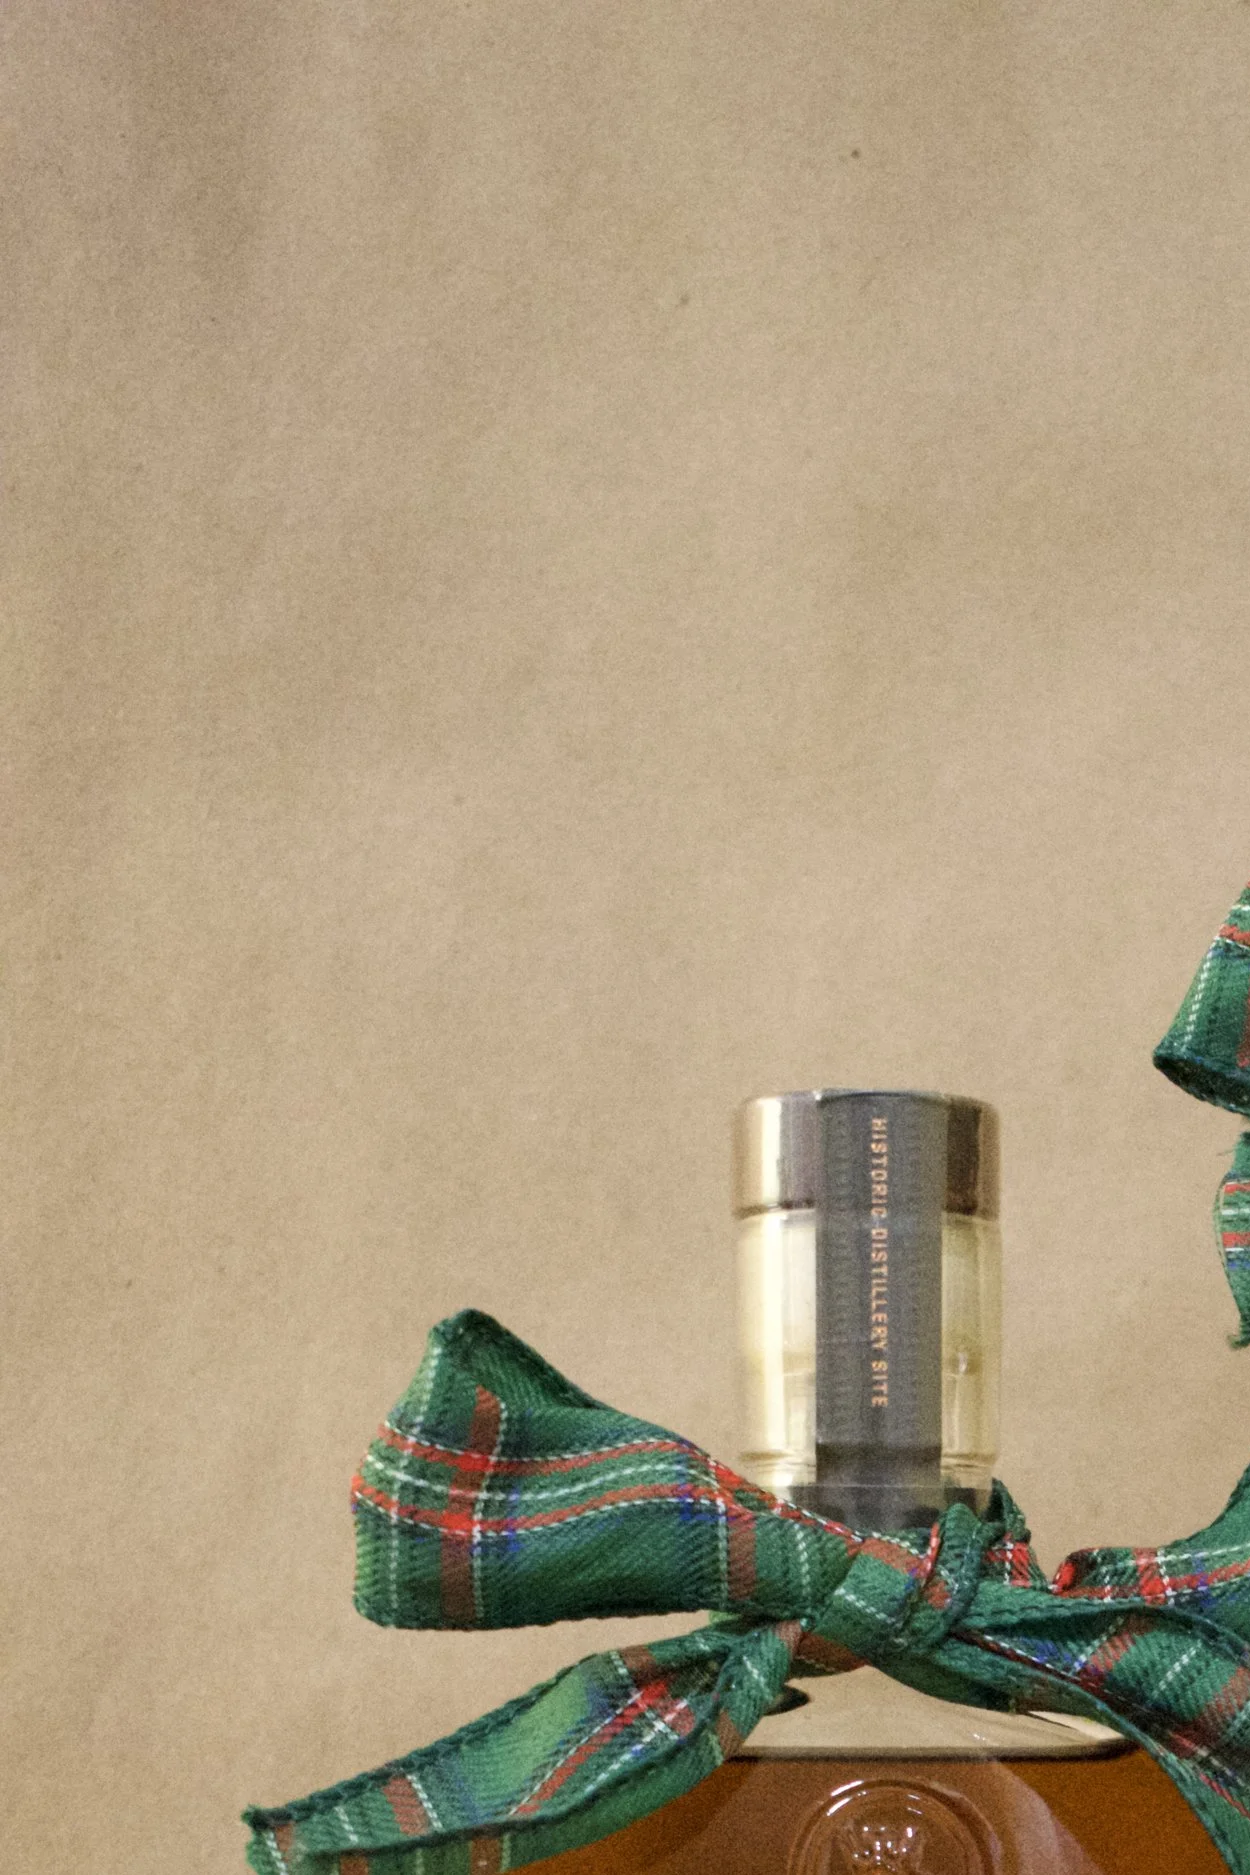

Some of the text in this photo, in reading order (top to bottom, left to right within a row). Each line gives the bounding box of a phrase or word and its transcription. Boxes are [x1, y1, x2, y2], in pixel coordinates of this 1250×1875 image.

[870, 1117, 889, 1408] HISTORIC DISTILLERY SITE
